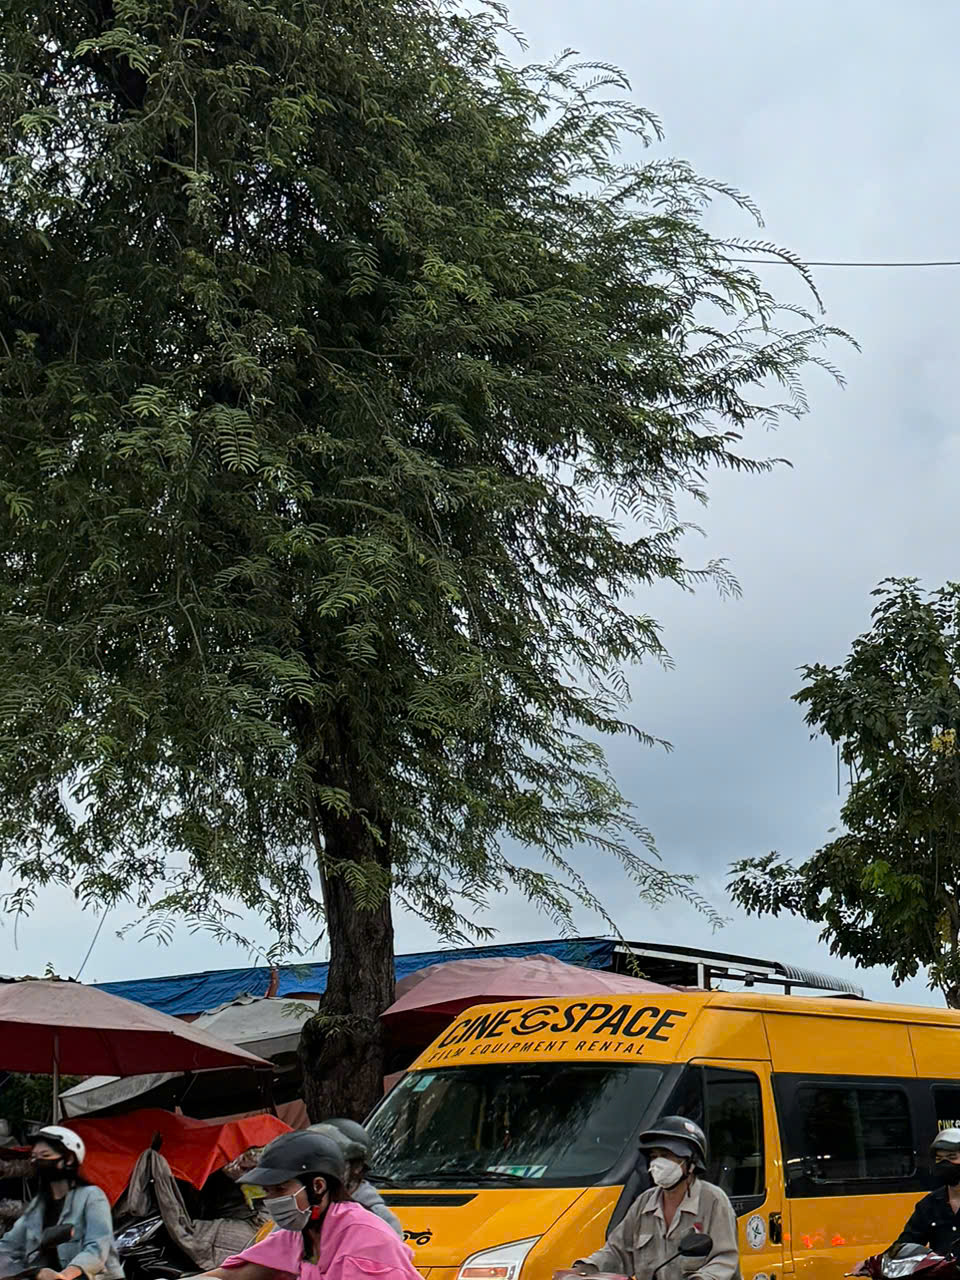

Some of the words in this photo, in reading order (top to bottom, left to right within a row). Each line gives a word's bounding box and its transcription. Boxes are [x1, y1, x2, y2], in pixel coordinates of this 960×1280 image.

[437, 1008, 523, 1049] CINE
[549, 1002, 688, 1043] SPACE
[427, 1047, 466, 1063] FILM
[469, 1040, 568, 1057] EQUIPMENT
[575, 1040, 645, 1056] RENTAL
